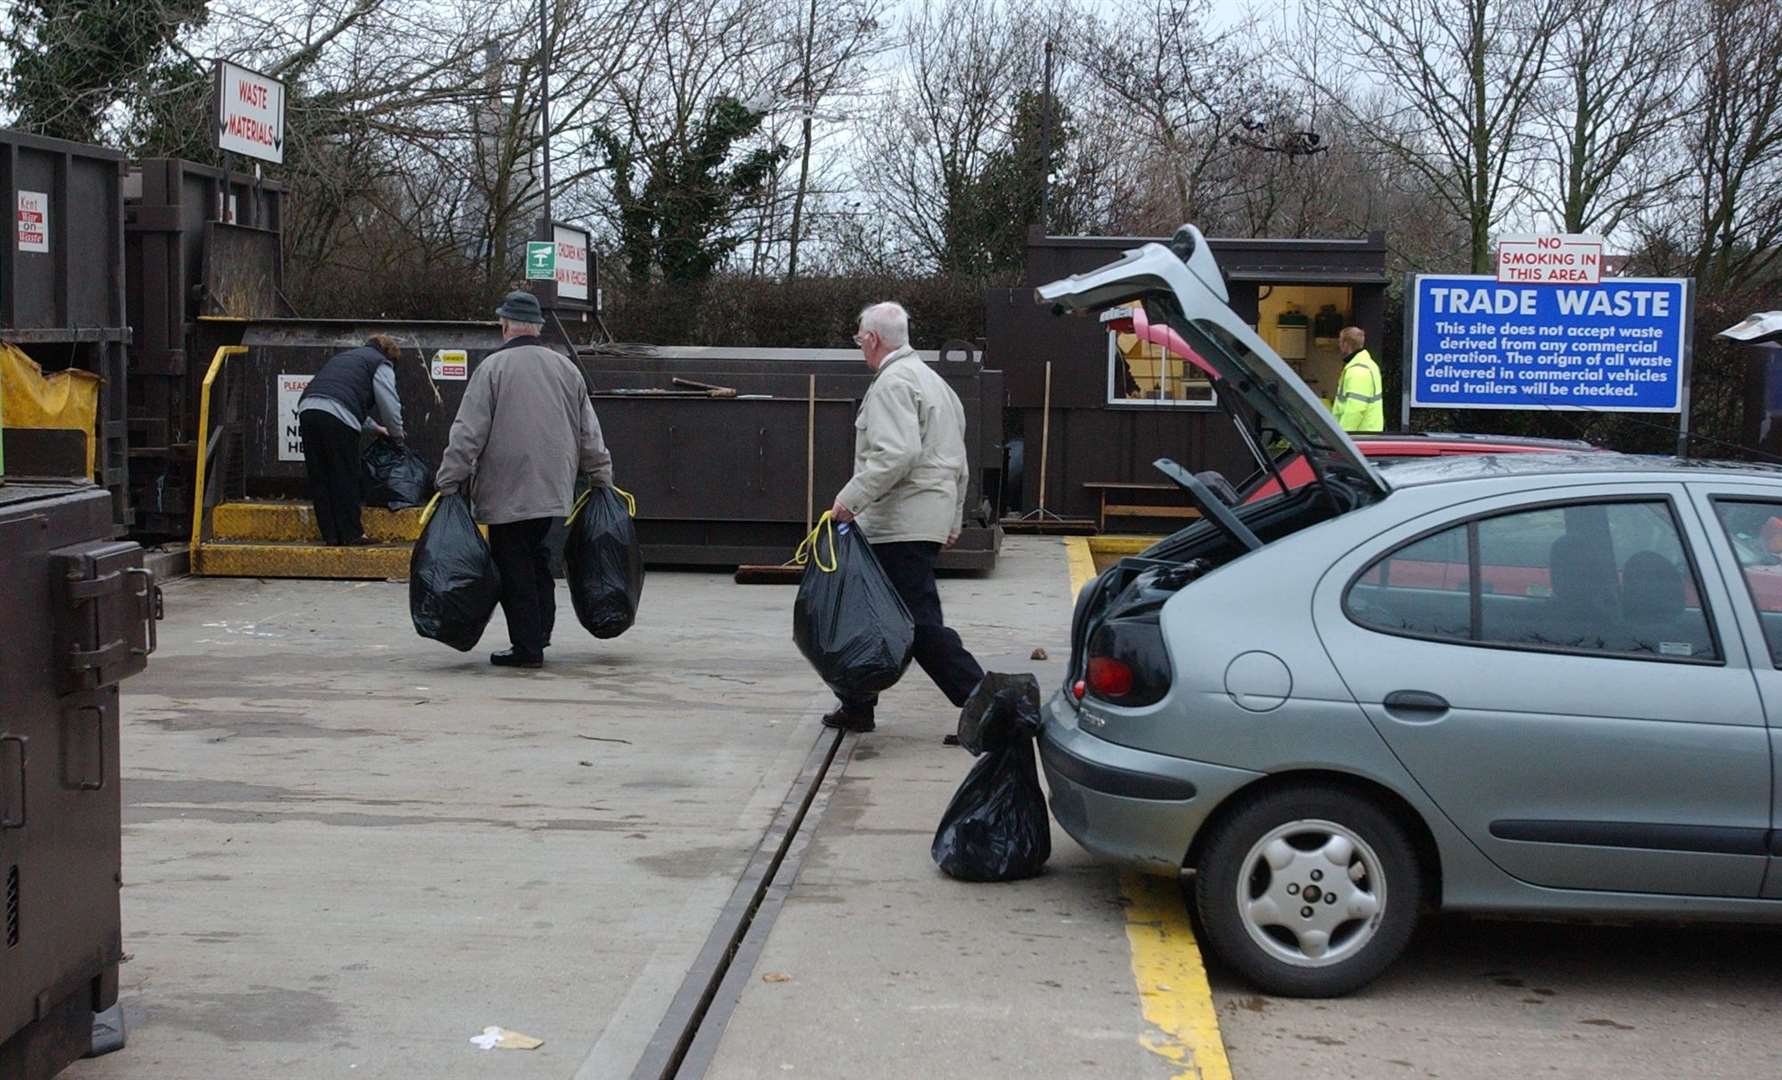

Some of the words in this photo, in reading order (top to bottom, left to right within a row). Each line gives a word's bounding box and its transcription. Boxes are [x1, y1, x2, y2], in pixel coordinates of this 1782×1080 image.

[239, 80, 267, 110] WASTE
[228, 113, 274, 146] MATERIALS
[23, 222, 37, 231] on
[19, 231, 42, 243] Waste
[1537, 237, 1562, 249] NO
[1502, 252, 1575, 265] SMOKING
[1581, 253, 1597, 265] IN
[1508, 268, 1542, 280] THIS
[1548, 269, 1588, 281] AREA
[1430, 287, 1537, 315] TRADE
[1556, 290, 1669, 318] WASTE
[1436, 322, 1465, 335] This
[1469, 322, 1495, 335] site
[1500, 323, 1535, 336] does
[1539, 324, 1564, 336] not
[1568, 325, 1616, 339] accept
[1619, 326, 1663, 338] waste
[1440, 337, 1497, 349] derived
[1501, 337, 1536, 350] from
[1539, 341, 1568, 354] any
[1571, 339, 1657, 353] commercial
[1424, 352, 1501, 366] operation.
[1506, 352, 1534, 365] The
[1538, 354, 1579, 367] origin
[1586, 353, 1603, 365] of
[1605, 353, 1624, 366] all
[1628, 355, 1673, 367] waste
[1425, 366, 1496, 379] delivered
[1500, 367, 1514, 379] in
[1518, 368, 1603, 381] commercial
[1607, 369, 1668, 382] vehicles
[284, 381, 308, 390] PLEAS
[1430, 381, 1459, 393] and
[1464, 382, 1517, 394] trailers
[1521, 383, 1547, 395] will
[1549, 383, 1569, 396] be
[1573, 384, 1638, 397] checked.
